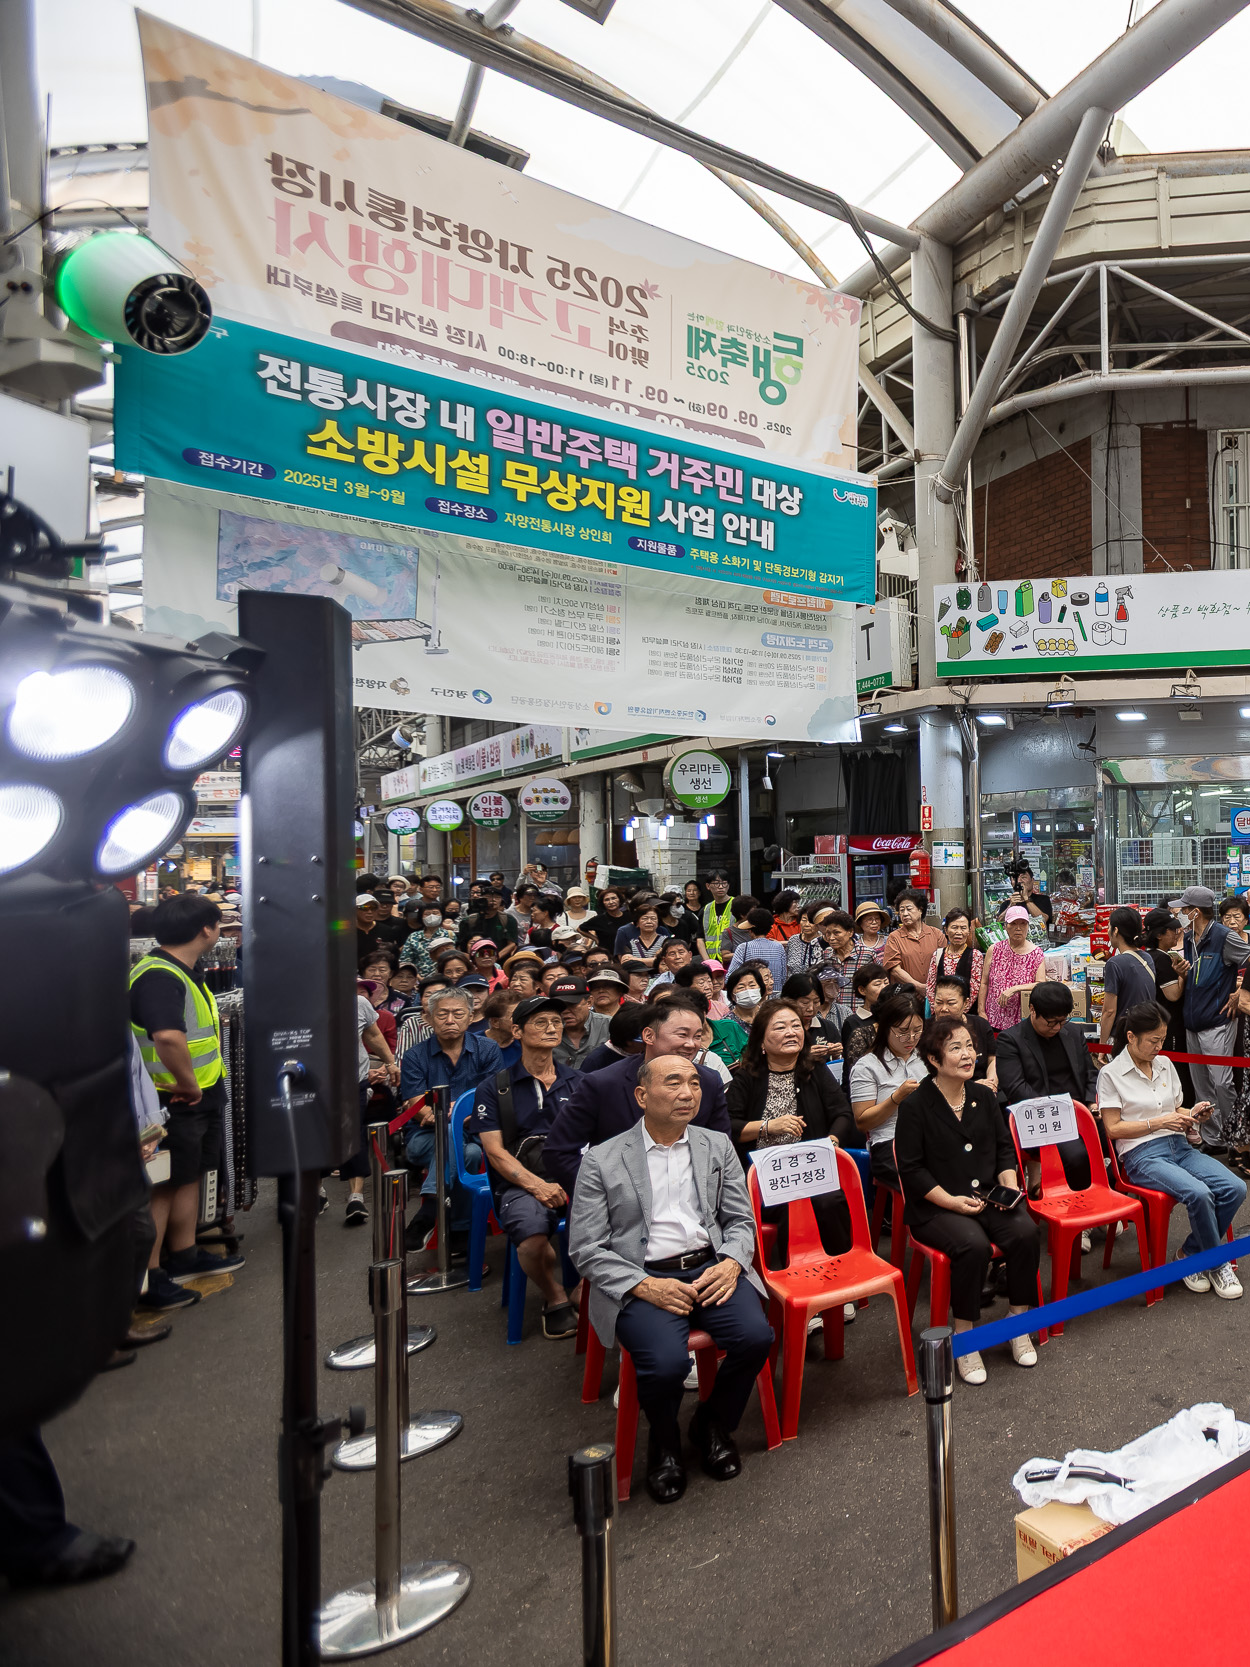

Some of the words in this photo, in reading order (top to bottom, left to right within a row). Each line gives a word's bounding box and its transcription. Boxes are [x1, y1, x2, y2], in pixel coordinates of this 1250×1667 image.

[257, 353, 430, 430] 전통시장
[439, 400, 475, 442] 내
[486, 408, 637, 480] 일반주택
[647, 448, 743, 504] 거주민
[752, 477, 803, 516] 대상
[307, 419, 490, 495] 소방시설
[502, 460, 650, 527] 무상지원
[658, 499, 715, 539] 사업
[722, 512, 775, 551] 안내
[198, 451, 263, 478] 접수기간
[284, 470, 337, 492] 2025년
[344, 481, 405, 505] 3월~9월
[437, 499, 488, 520] 접수장소
[504, 512, 576, 537] 자양전통시장
[579, 527, 612, 544] 상인회
[636, 538, 677, 556] 지원물품
[690, 548, 719, 564] 주택용
[722, 555, 750, 570] 소화기
[753, 560, 761, 572] 및
[764, 562, 816, 582] 단독경보기형
[819, 572, 844, 586] 감지기
[1158, 604, 1192, 619] 상품의
[857, 676, 885, 690] T.444-0772
[677, 763, 722, 776] 우리마트
[690, 778, 712, 790] 생선
[481, 795, 503, 806] 이불
[694, 795, 708, 803] 생선
[482, 807, 504, 817] 잡화
[872, 836, 914, 850] Coca-Cola
[1025, 1106, 1060, 1120] 이동길
[1027, 1121, 1062, 1135] 구의원
[771, 1151, 818, 1171] 김경호
[768, 1168, 826, 1190] 광진구청장
[1018, 1529, 1037, 1549] 테팔
